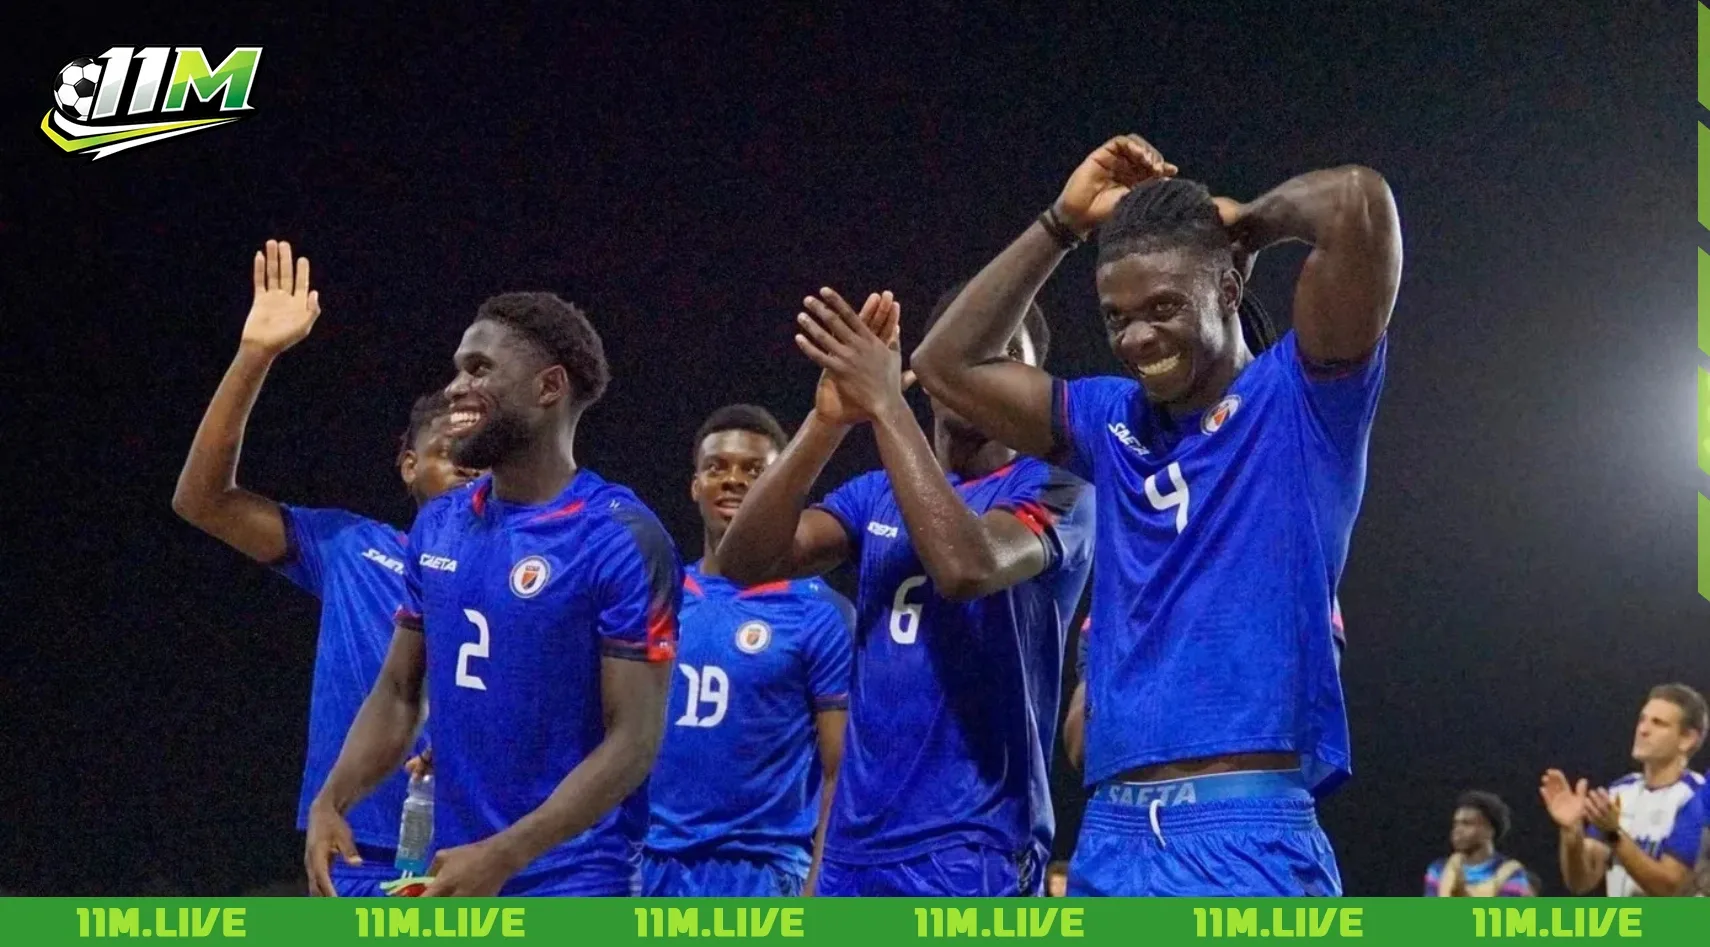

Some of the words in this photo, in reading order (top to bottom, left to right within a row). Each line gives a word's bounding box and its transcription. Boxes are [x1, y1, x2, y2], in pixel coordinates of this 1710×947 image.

[1144, 461, 1189, 535] 4
[890, 575, 927, 644] 6
[455, 608, 490, 690] 2
[675, 663, 729, 727] 19
[1109, 782, 1197, 806] SAETA
